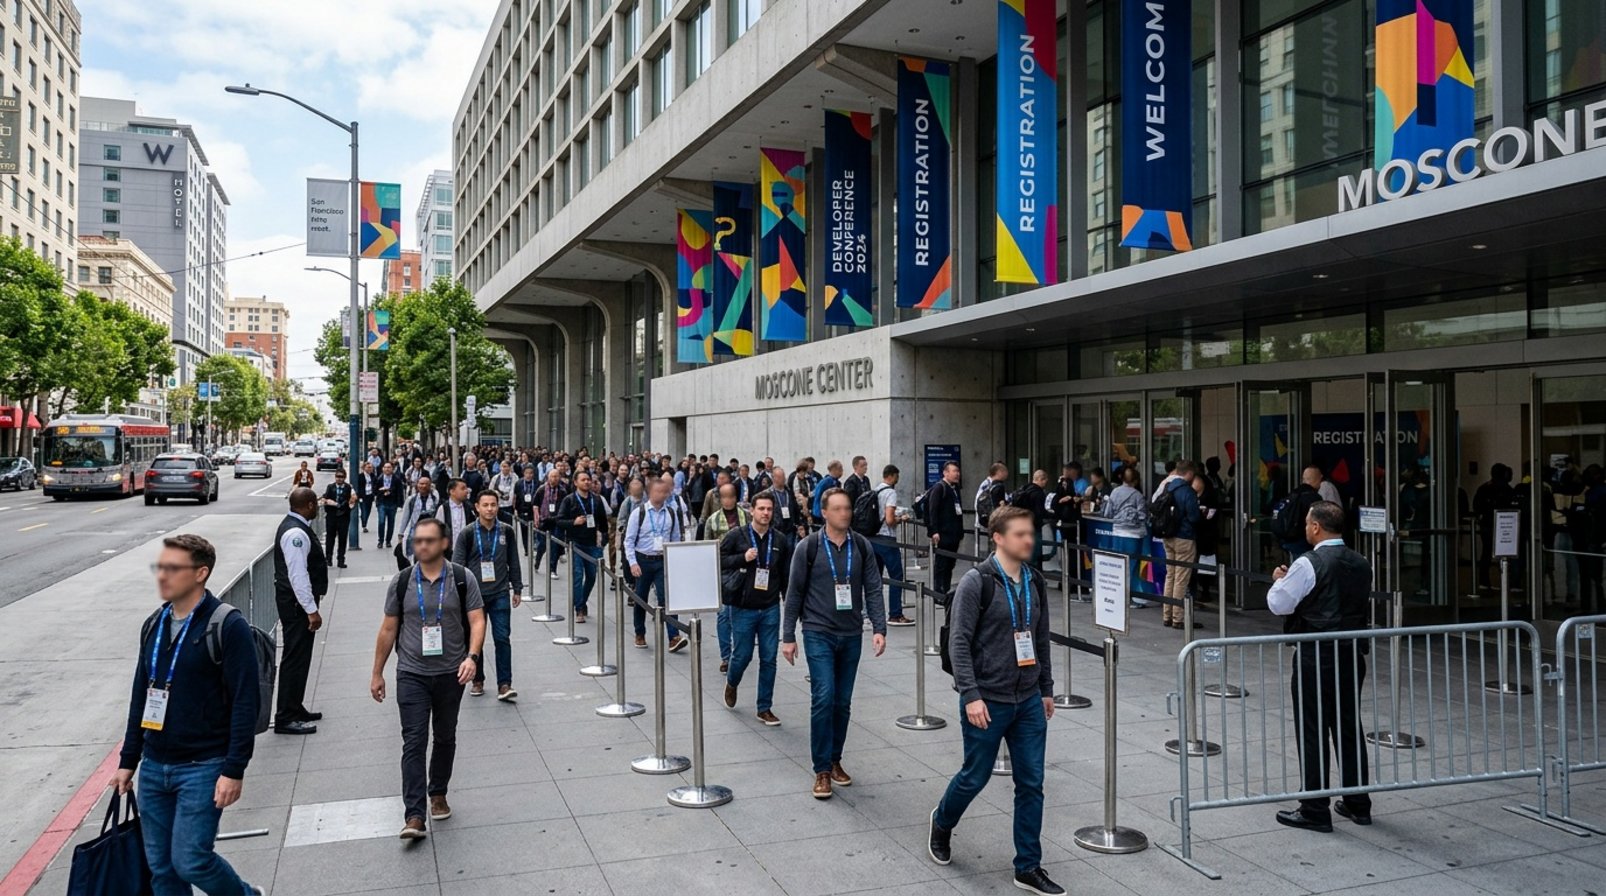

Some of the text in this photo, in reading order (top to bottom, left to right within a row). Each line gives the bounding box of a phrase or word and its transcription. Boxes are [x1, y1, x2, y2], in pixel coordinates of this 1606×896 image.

[1018, 33, 1035, 233] REGISTRATION
[1143, 1, 1167, 163] WELCOM
[143, 142, 174, 166] W
[914, 98, 929, 267] REGISTRATION
[1337, 108, 1606, 214] MOSCONE
[831, 179, 842, 273] DEVELOPER
[843, 170, 855, 274] CONFERENCE
[755, 356, 873, 400] MOSCONE CENTER
[1313, 431, 1418, 444] REGISTAON
